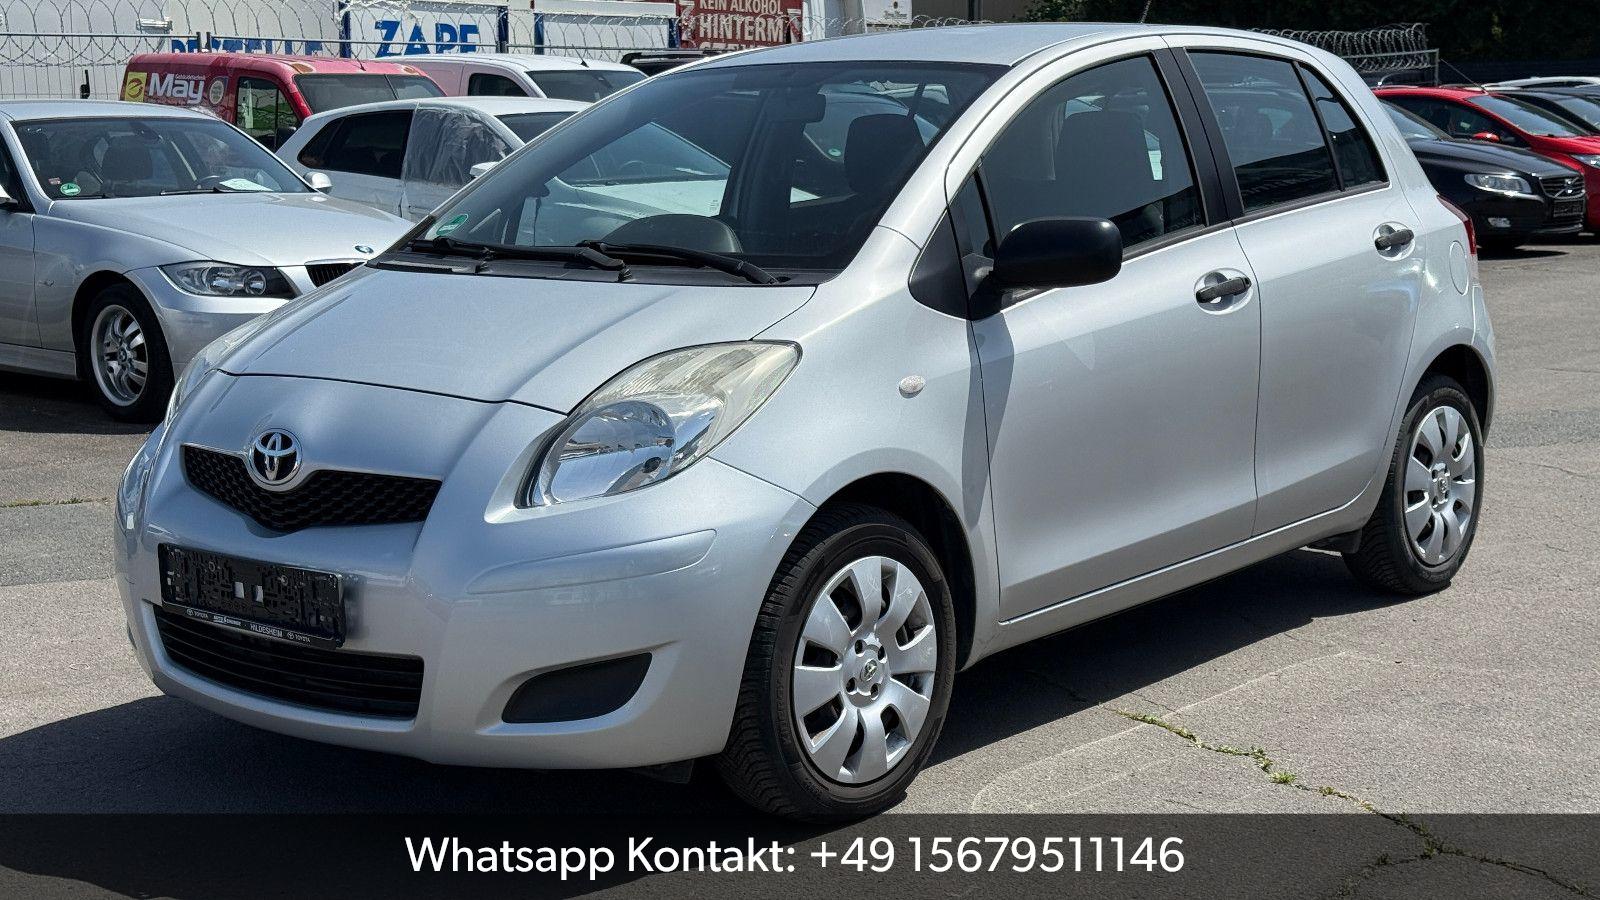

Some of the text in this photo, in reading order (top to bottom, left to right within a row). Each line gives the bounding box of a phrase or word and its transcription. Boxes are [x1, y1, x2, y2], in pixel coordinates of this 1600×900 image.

[699, 0, 784, 14] KEIN ALKOHOL
[699, 12, 784, 43] HINTERM
[148, 72, 205, 104] May
[249, 623, 283, 638] HILDESHEIM
